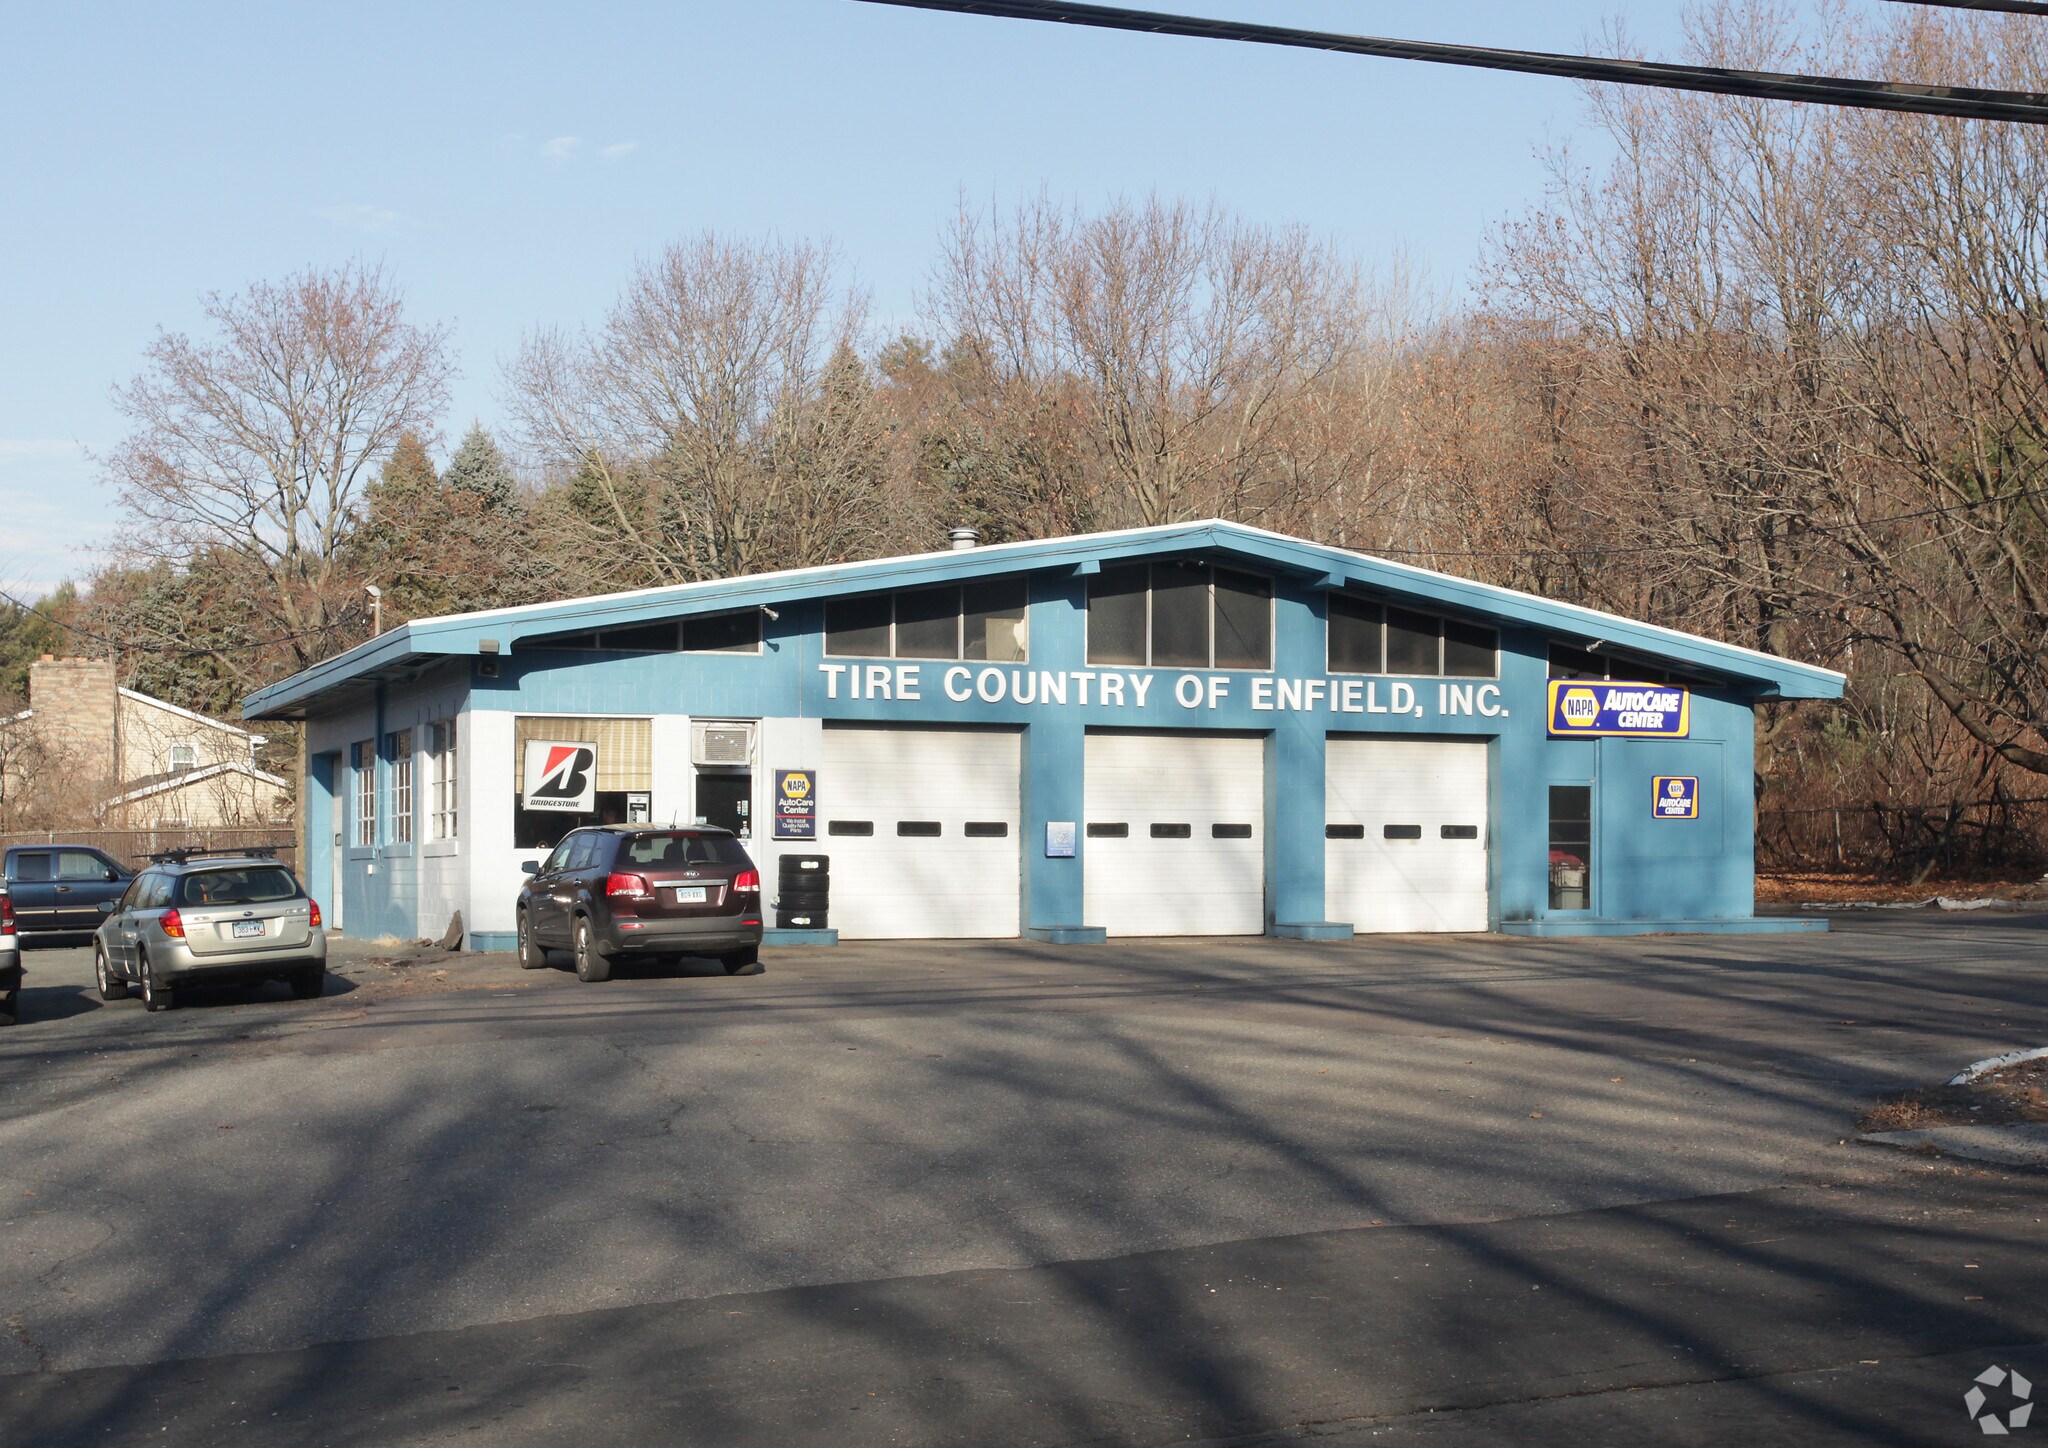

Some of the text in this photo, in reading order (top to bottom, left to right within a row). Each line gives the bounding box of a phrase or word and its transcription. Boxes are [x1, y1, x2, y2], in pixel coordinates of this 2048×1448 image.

[818, 664, 1509, 718] TIRE COUNTRY OF ENFIELD, INC.
[1567, 698, 1594, 716] NAPA
[1618, 712, 1663, 728] CENTER
[787, 780, 806, 791] NAPA
[1670, 784, 1682, 793] NAPA
[530, 799, 580, 807] BRIDGESTONE
[779, 798, 814, 806] AutoCare
[783, 806, 809, 814] Center
